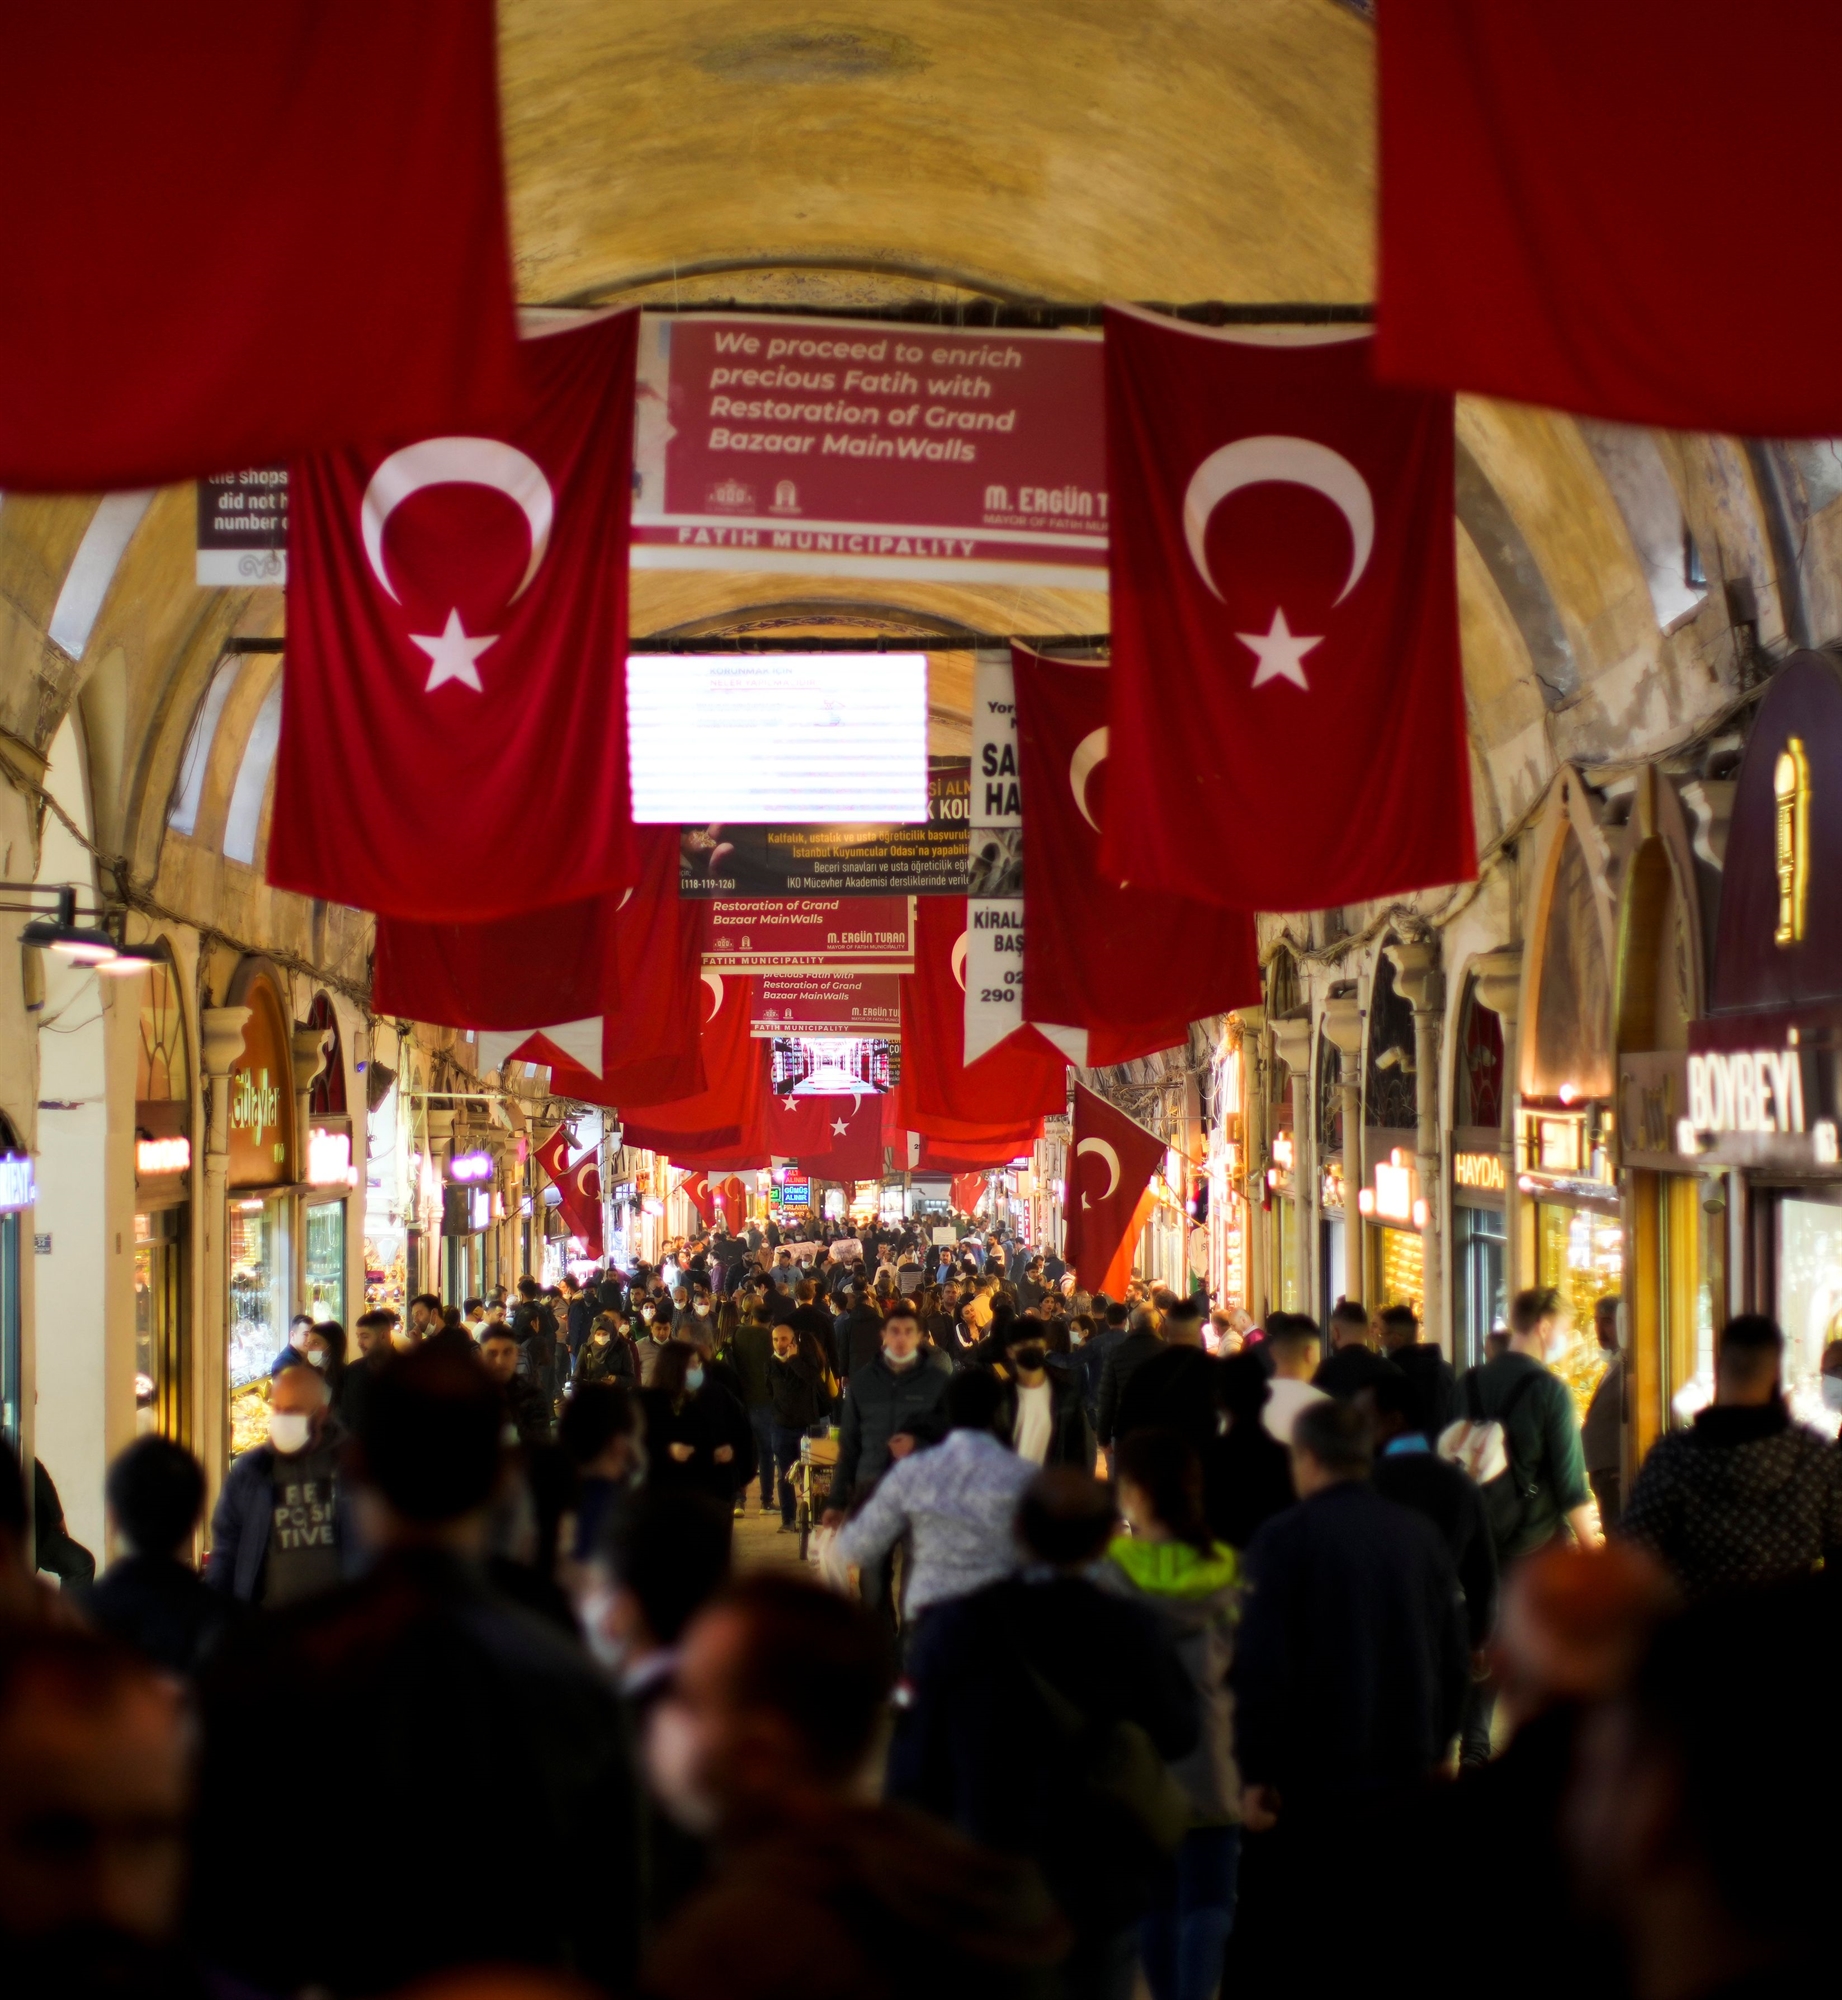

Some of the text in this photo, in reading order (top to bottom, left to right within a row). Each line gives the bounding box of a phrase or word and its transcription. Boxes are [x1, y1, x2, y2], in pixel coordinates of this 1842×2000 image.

[714, 331, 1022, 368] We proceed to enrich
[710, 366, 991, 398] precious Fatih with
[710, 397, 1016, 432] Restoration of Grand
[708, 428, 815, 454] Bazaar
[239, 470, 288, 488] shops
[218, 492, 244, 510] did
[249, 495, 276, 510] not
[214, 512, 276, 531] number
[678, 528, 977, 558] FATIH MUNICIPALITY
[767, 832, 806, 845] Kalfalık,
[809, 833, 842, 844] ustalık
[844, 835, 855, 844] ve
[856, 832, 876, 843] usta
[878, 830, 926, 845] öğreticilik
[793, 846, 831, 858] İstanbul
[833, 847, 888, 860] Kuyumcular
[814, 862, 841, 873] Beceri
[842, 861, 877, 872] sınavları
[879, 863, 889, 871] ve
[890, 862, 909, 871] usta
[911, 860, 953, 874] öğreticilik
[803, 876, 843, 888] Mücevher
[844, 876, 888, 888] Akademisi
[889, 875, 946, 887] dersliklerinde
[713, 900, 839, 911] Restoration of Grand
[713, 915, 757, 925] Bazaar
[702, 956, 825, 965] FATIH MUNICIPALITY
[763, 981, 818, 989] Restoration
[832, 982, 862, 990] Grand
[981, 989, 1015, 1002] 290
[784, 1186, 808, 1195] GÜMÜŞ
[280, 1525, 334, 1549] TIVE
